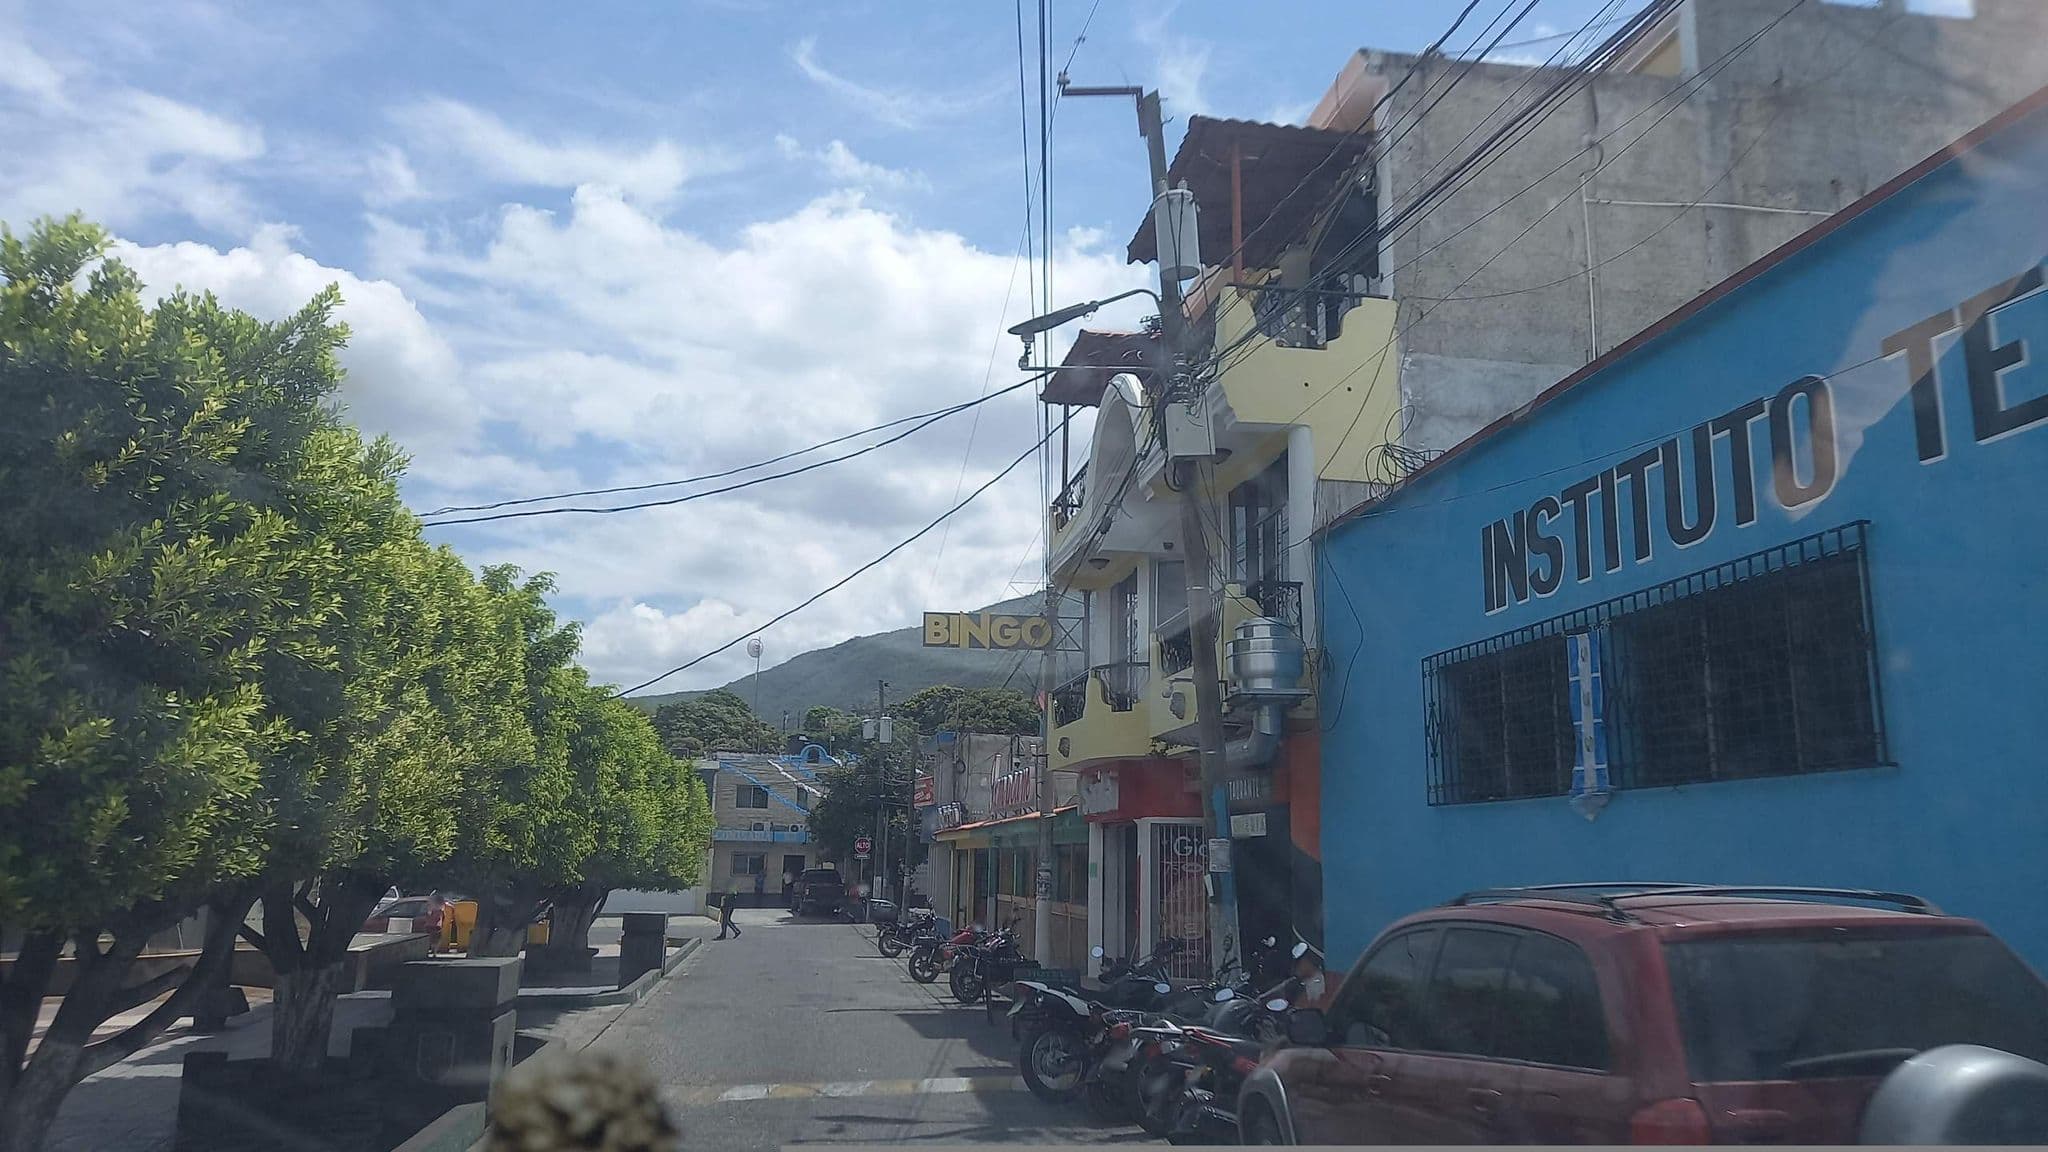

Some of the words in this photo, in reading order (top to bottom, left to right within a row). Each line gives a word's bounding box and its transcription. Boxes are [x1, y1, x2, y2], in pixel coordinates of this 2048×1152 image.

[1481, 374, 1838, 616] INSTITUTO
[1881, 261, 2048, 466] TE
[925, 611, 1052, 650] BINGO
